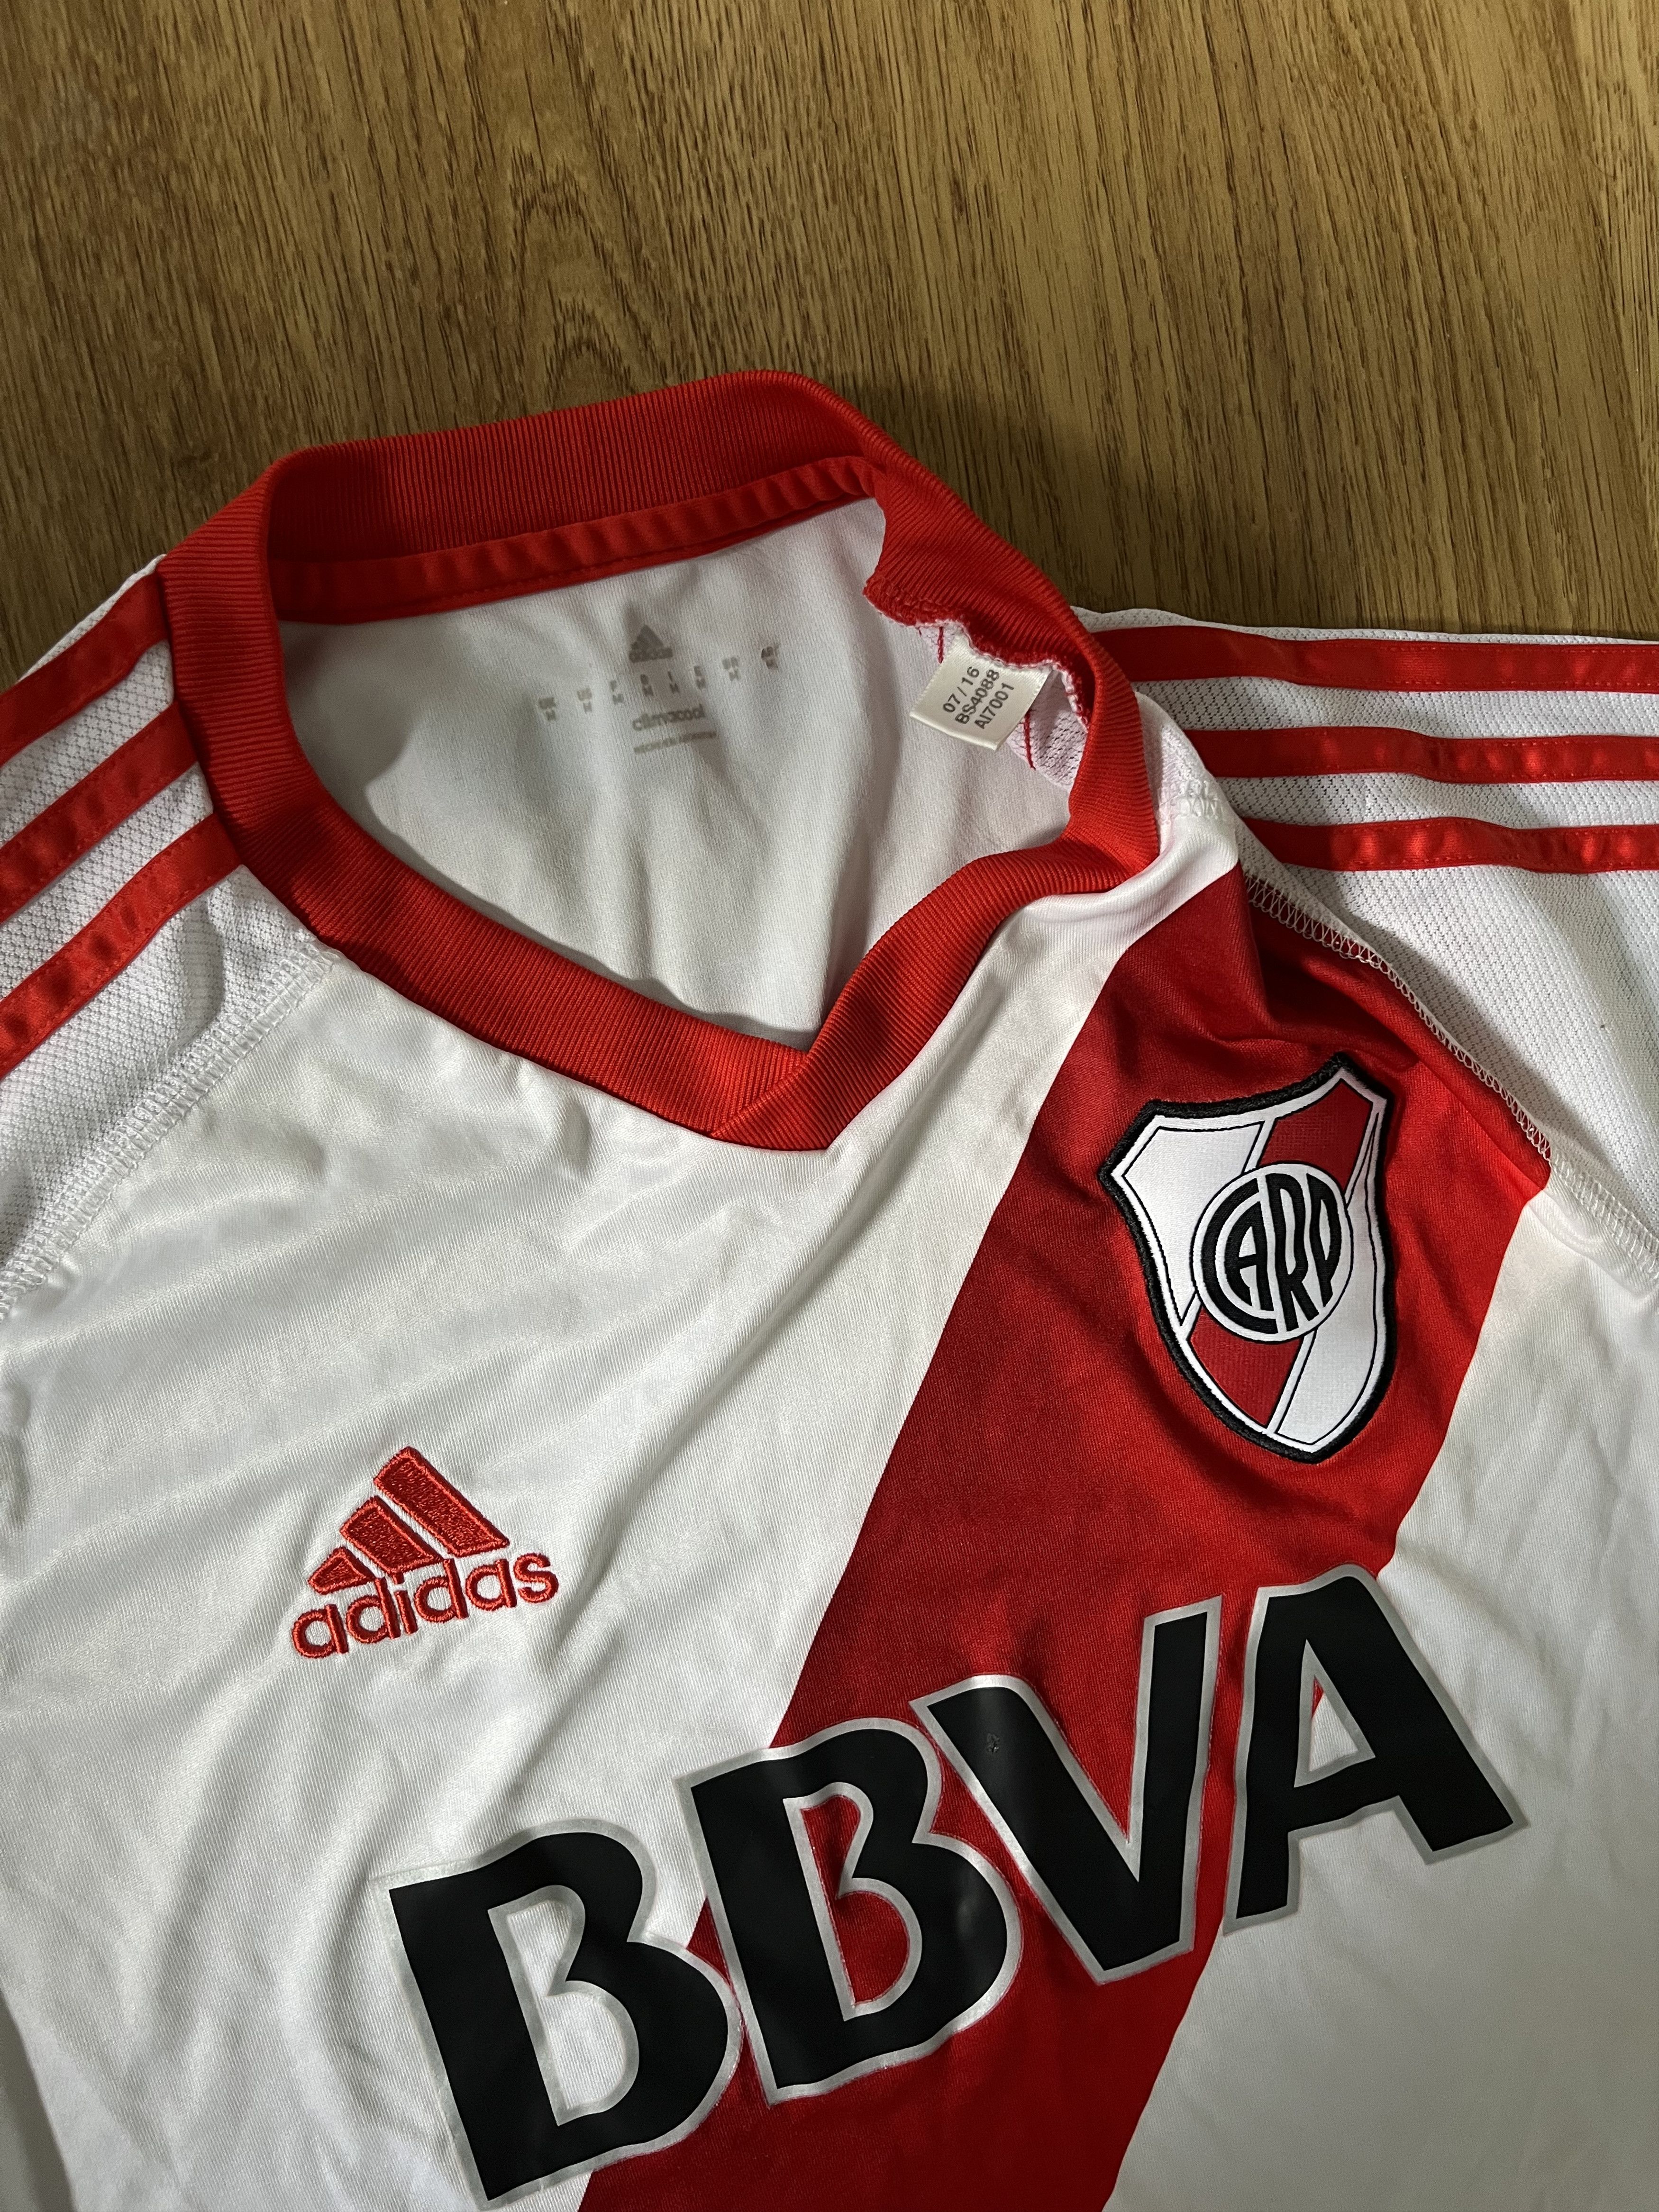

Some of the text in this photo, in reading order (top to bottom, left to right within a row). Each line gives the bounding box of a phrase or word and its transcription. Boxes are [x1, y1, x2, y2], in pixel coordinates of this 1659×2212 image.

[942, 666, 979, 712] 07/16
[955, 669, 1000, 724] BS4088
[974, 683, 1014, 729] AI7001
[292, 1553, 559, 1659] adidas
[372, 1564, 1527, 2210] BBVA
